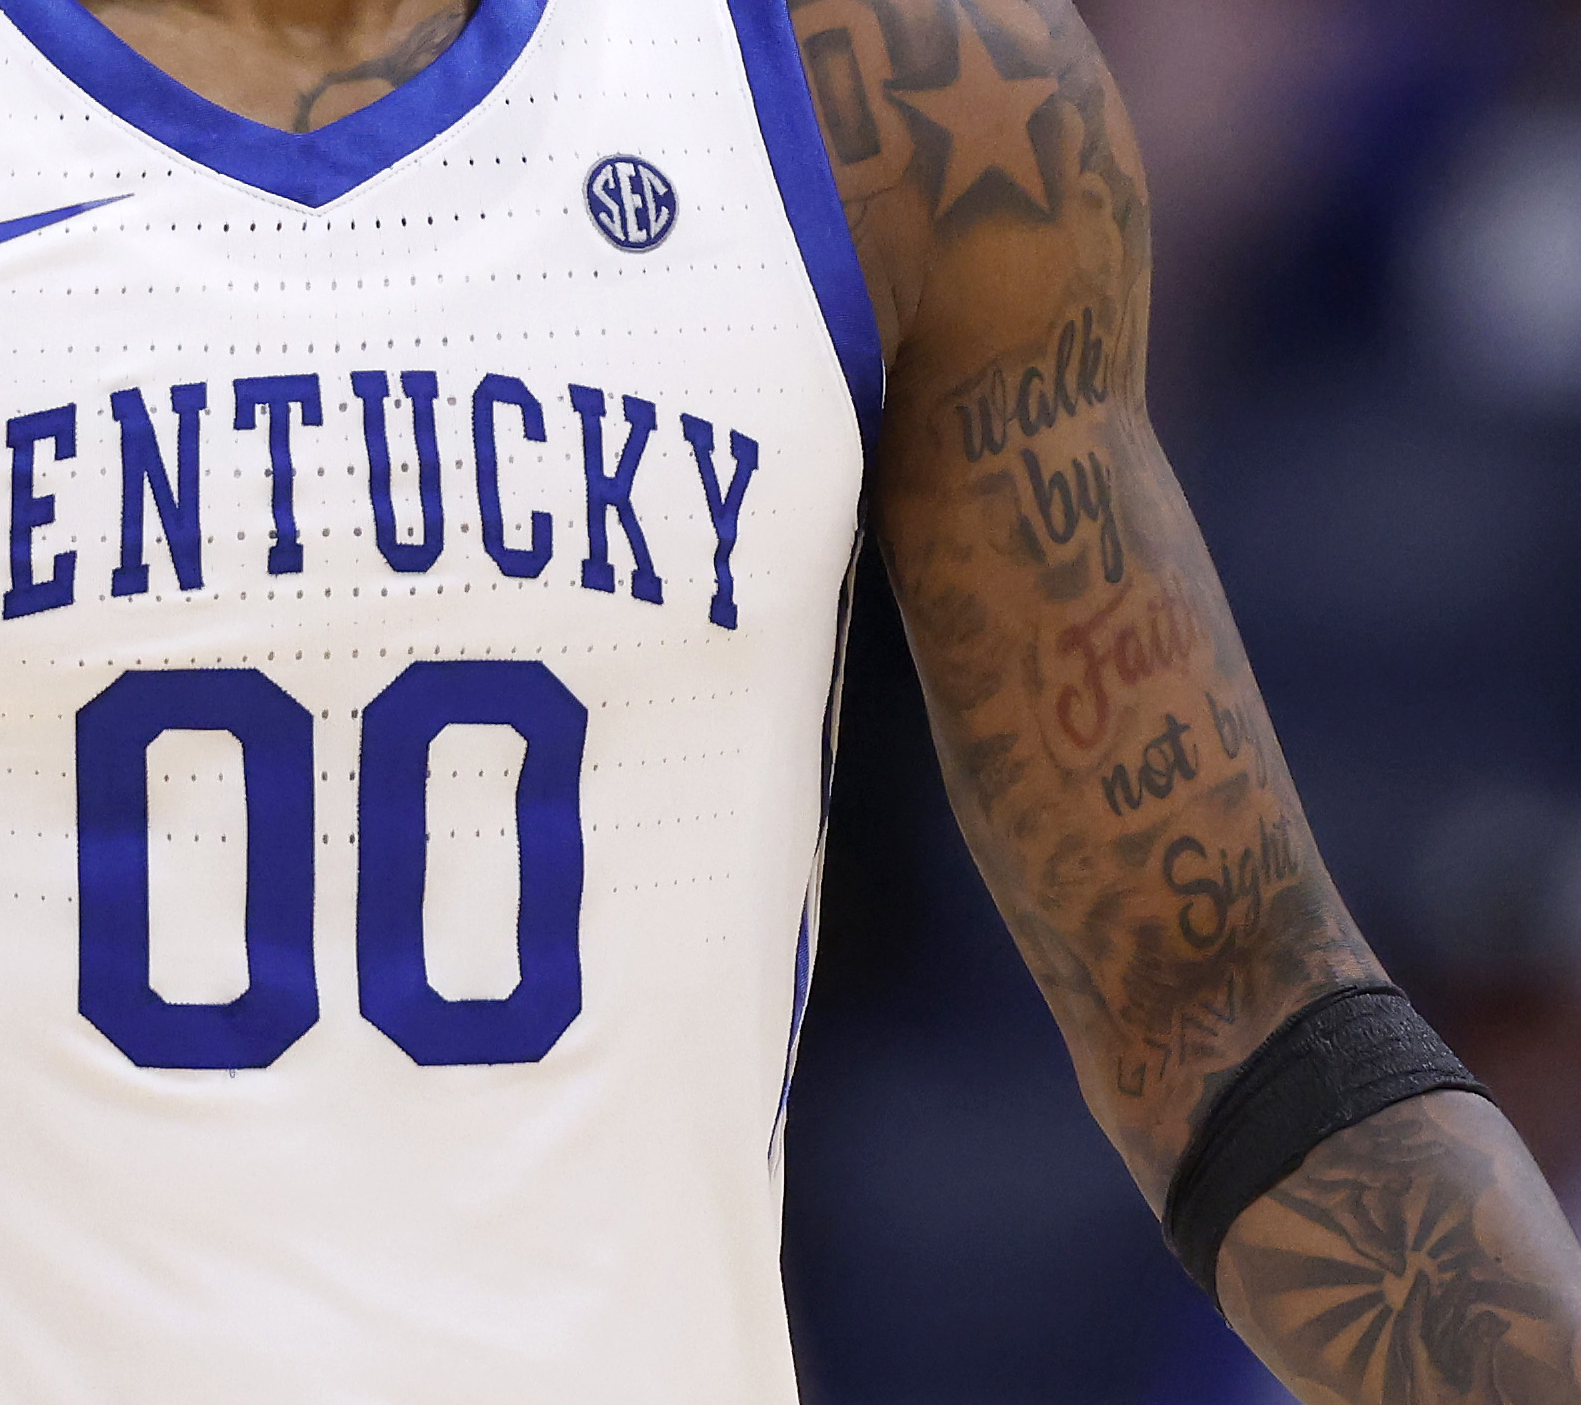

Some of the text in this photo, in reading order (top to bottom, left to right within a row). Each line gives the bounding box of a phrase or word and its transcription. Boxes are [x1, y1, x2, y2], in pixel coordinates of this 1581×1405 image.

[589, 157, 671, 244] SEC
[953, 305, 1110, 463] walk
[1020, 446, 1126, 584] by
[1101, 712, 1200, 818] not
[75, 659, 589, 1070] 00
[1162, 812, 1303, 950] Sight
